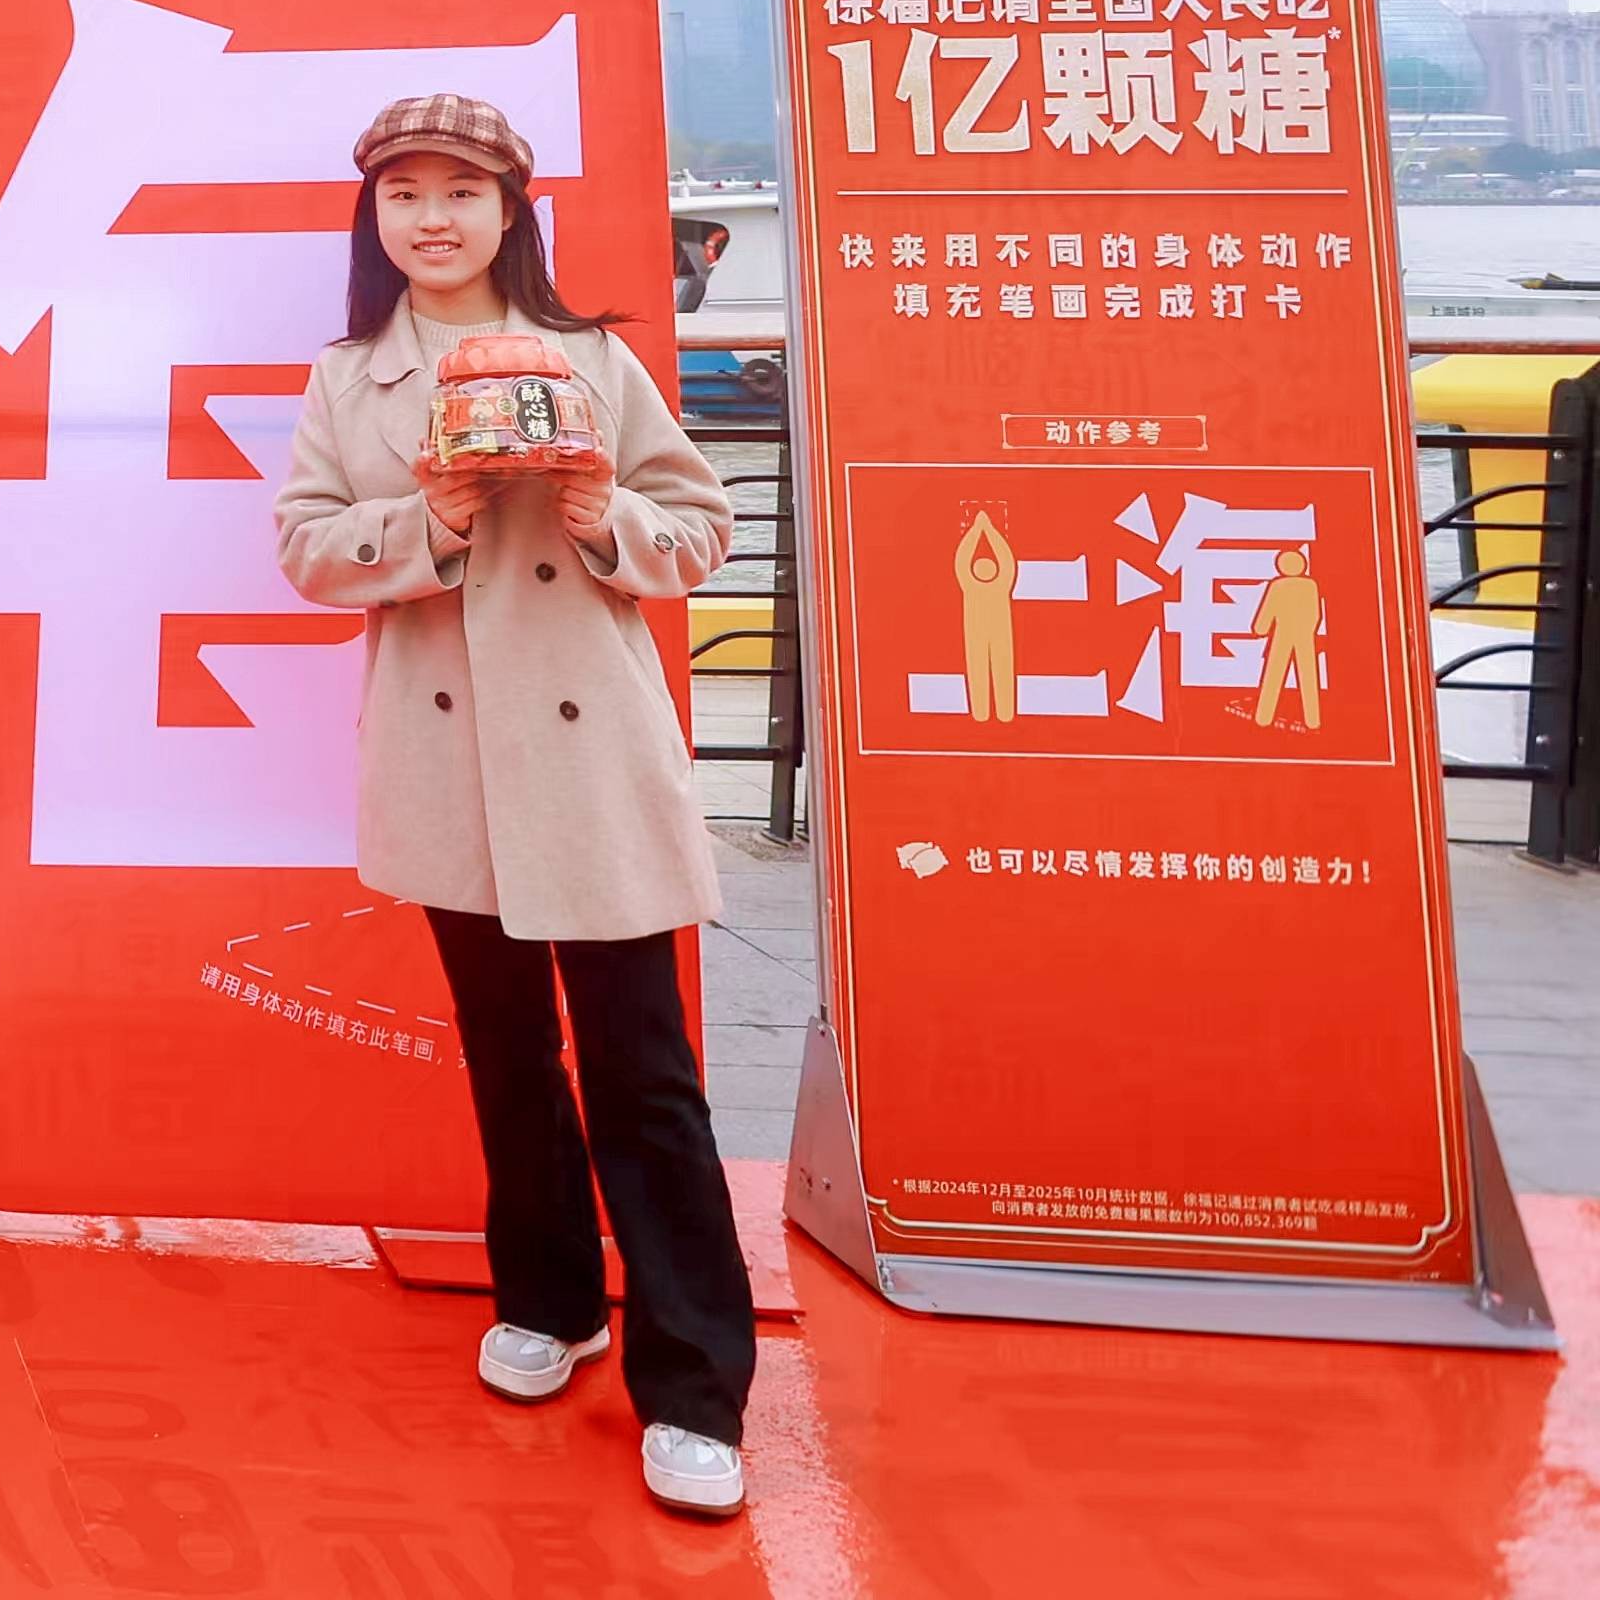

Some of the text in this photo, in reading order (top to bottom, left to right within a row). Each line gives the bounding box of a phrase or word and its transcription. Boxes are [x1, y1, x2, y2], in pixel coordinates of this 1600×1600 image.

[839, 232, 1353, 270] 快来用不同的身体动作
[893, 283, 1304, 319] 填充笔画完成打卡
[520, 382, 551, 440] 酥心糖
[1045, 419, 1163, 446] 动作参考
[200, 961, 468, 1070] 请用身体动作填充此笔画，
